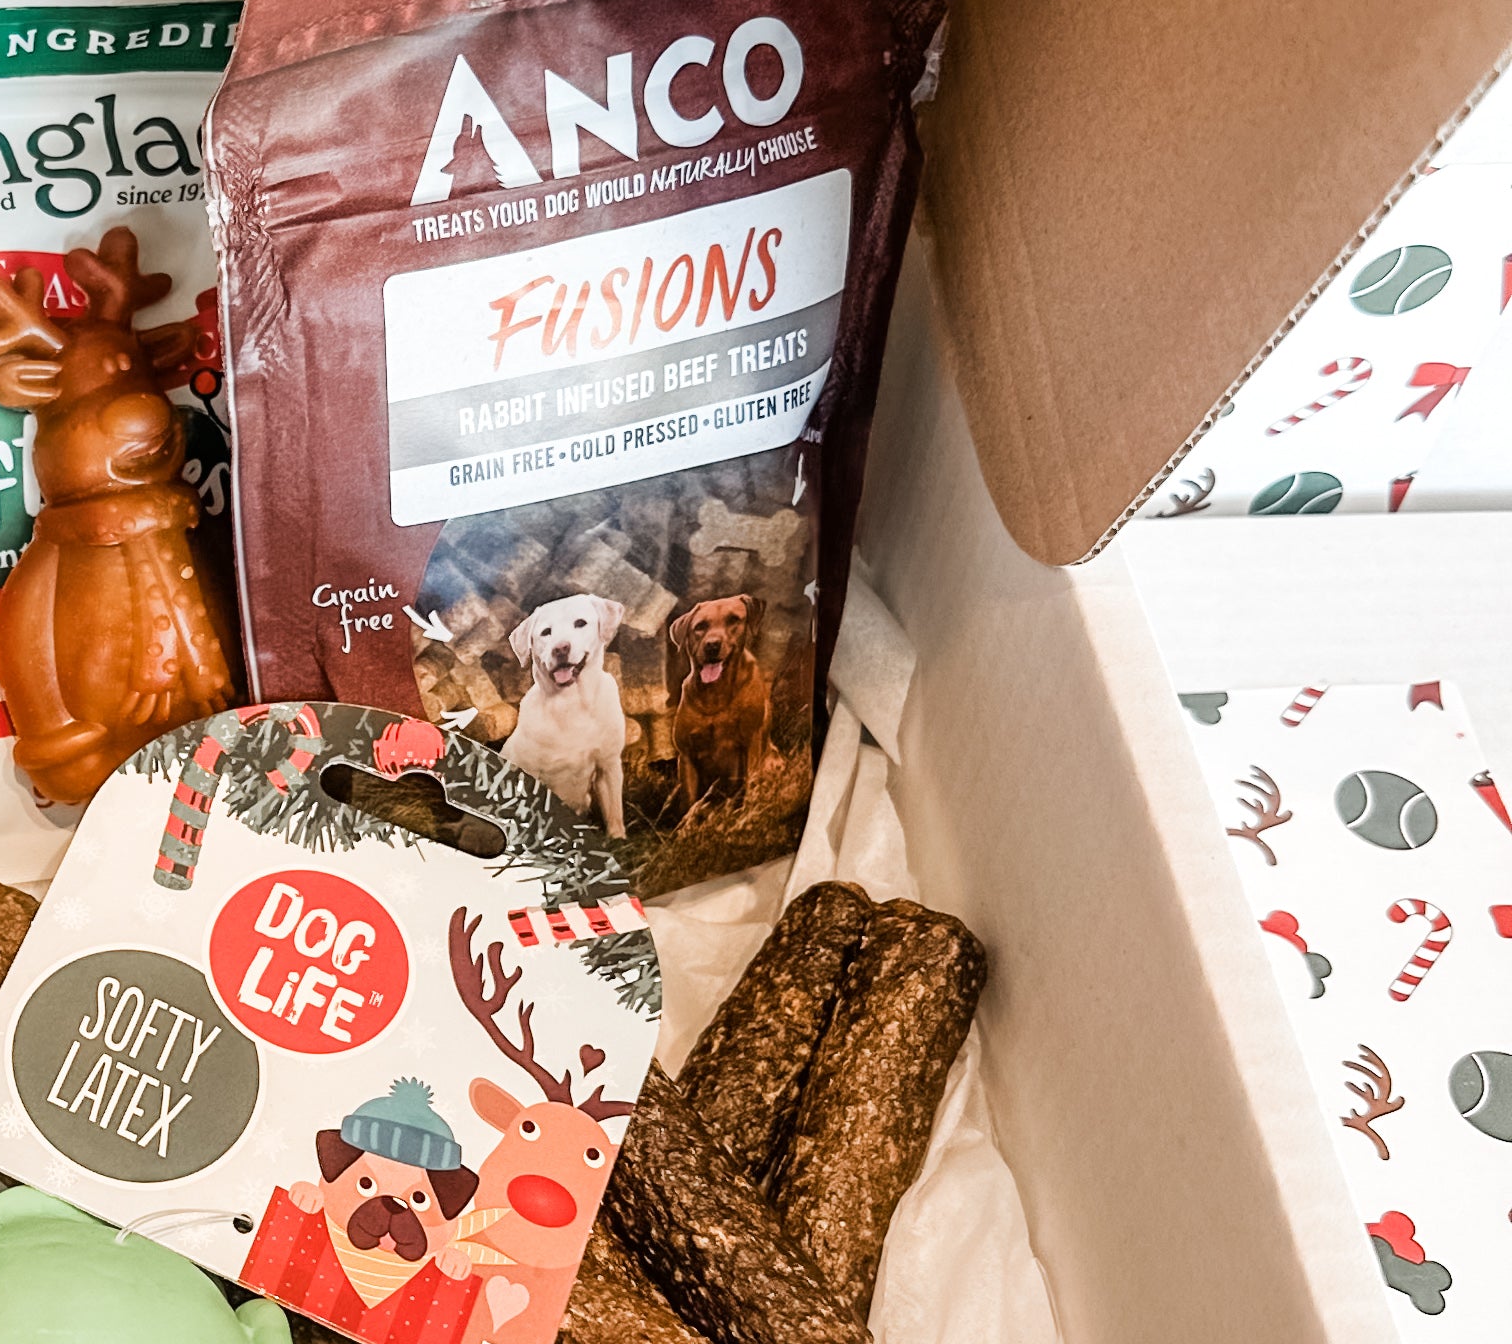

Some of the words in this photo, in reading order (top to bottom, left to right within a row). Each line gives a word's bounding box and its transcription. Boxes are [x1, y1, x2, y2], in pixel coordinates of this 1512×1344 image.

[409, 15, 805, 207] ANCO
[116, 185, 173, 206] since
[177, 183, 206, 203] 197
[411, 208, 485, 244] TREATS
[487, 196, 539, 229] YOUR
[544, 188, 580, 219] DOG
[585, 173, 646, 209] WOULD
[649, 146, 757, 195] NATURALLY
[758, 126, 818, 165] CHOOSE
[487, 226, 783, 372] FUSIONS
[449, 458, 505, 487] GRAIN
[512, 446, 556, 475] FREE
[570, 434, 616, 463] COLD
[623, 414, 699, 452] PRESSED
[713, 394, 778, 430] GLUTEN
[783, 380, 812, 414] FREE
[458, 392, 547, 437] RABBIT
[556, 370, 655, 418] INFUSED
[663, 353, 720, 393] BEEF
[727, 328, 809, 377] TREATS
[311, 578, 400, 609] Grain
[339, 608, 396, 655] free
[253, 881, 377, 976] DOG
[78, 976, 223, 1085] SOFTY
[46, 1040, 193, 1159] LATEX
